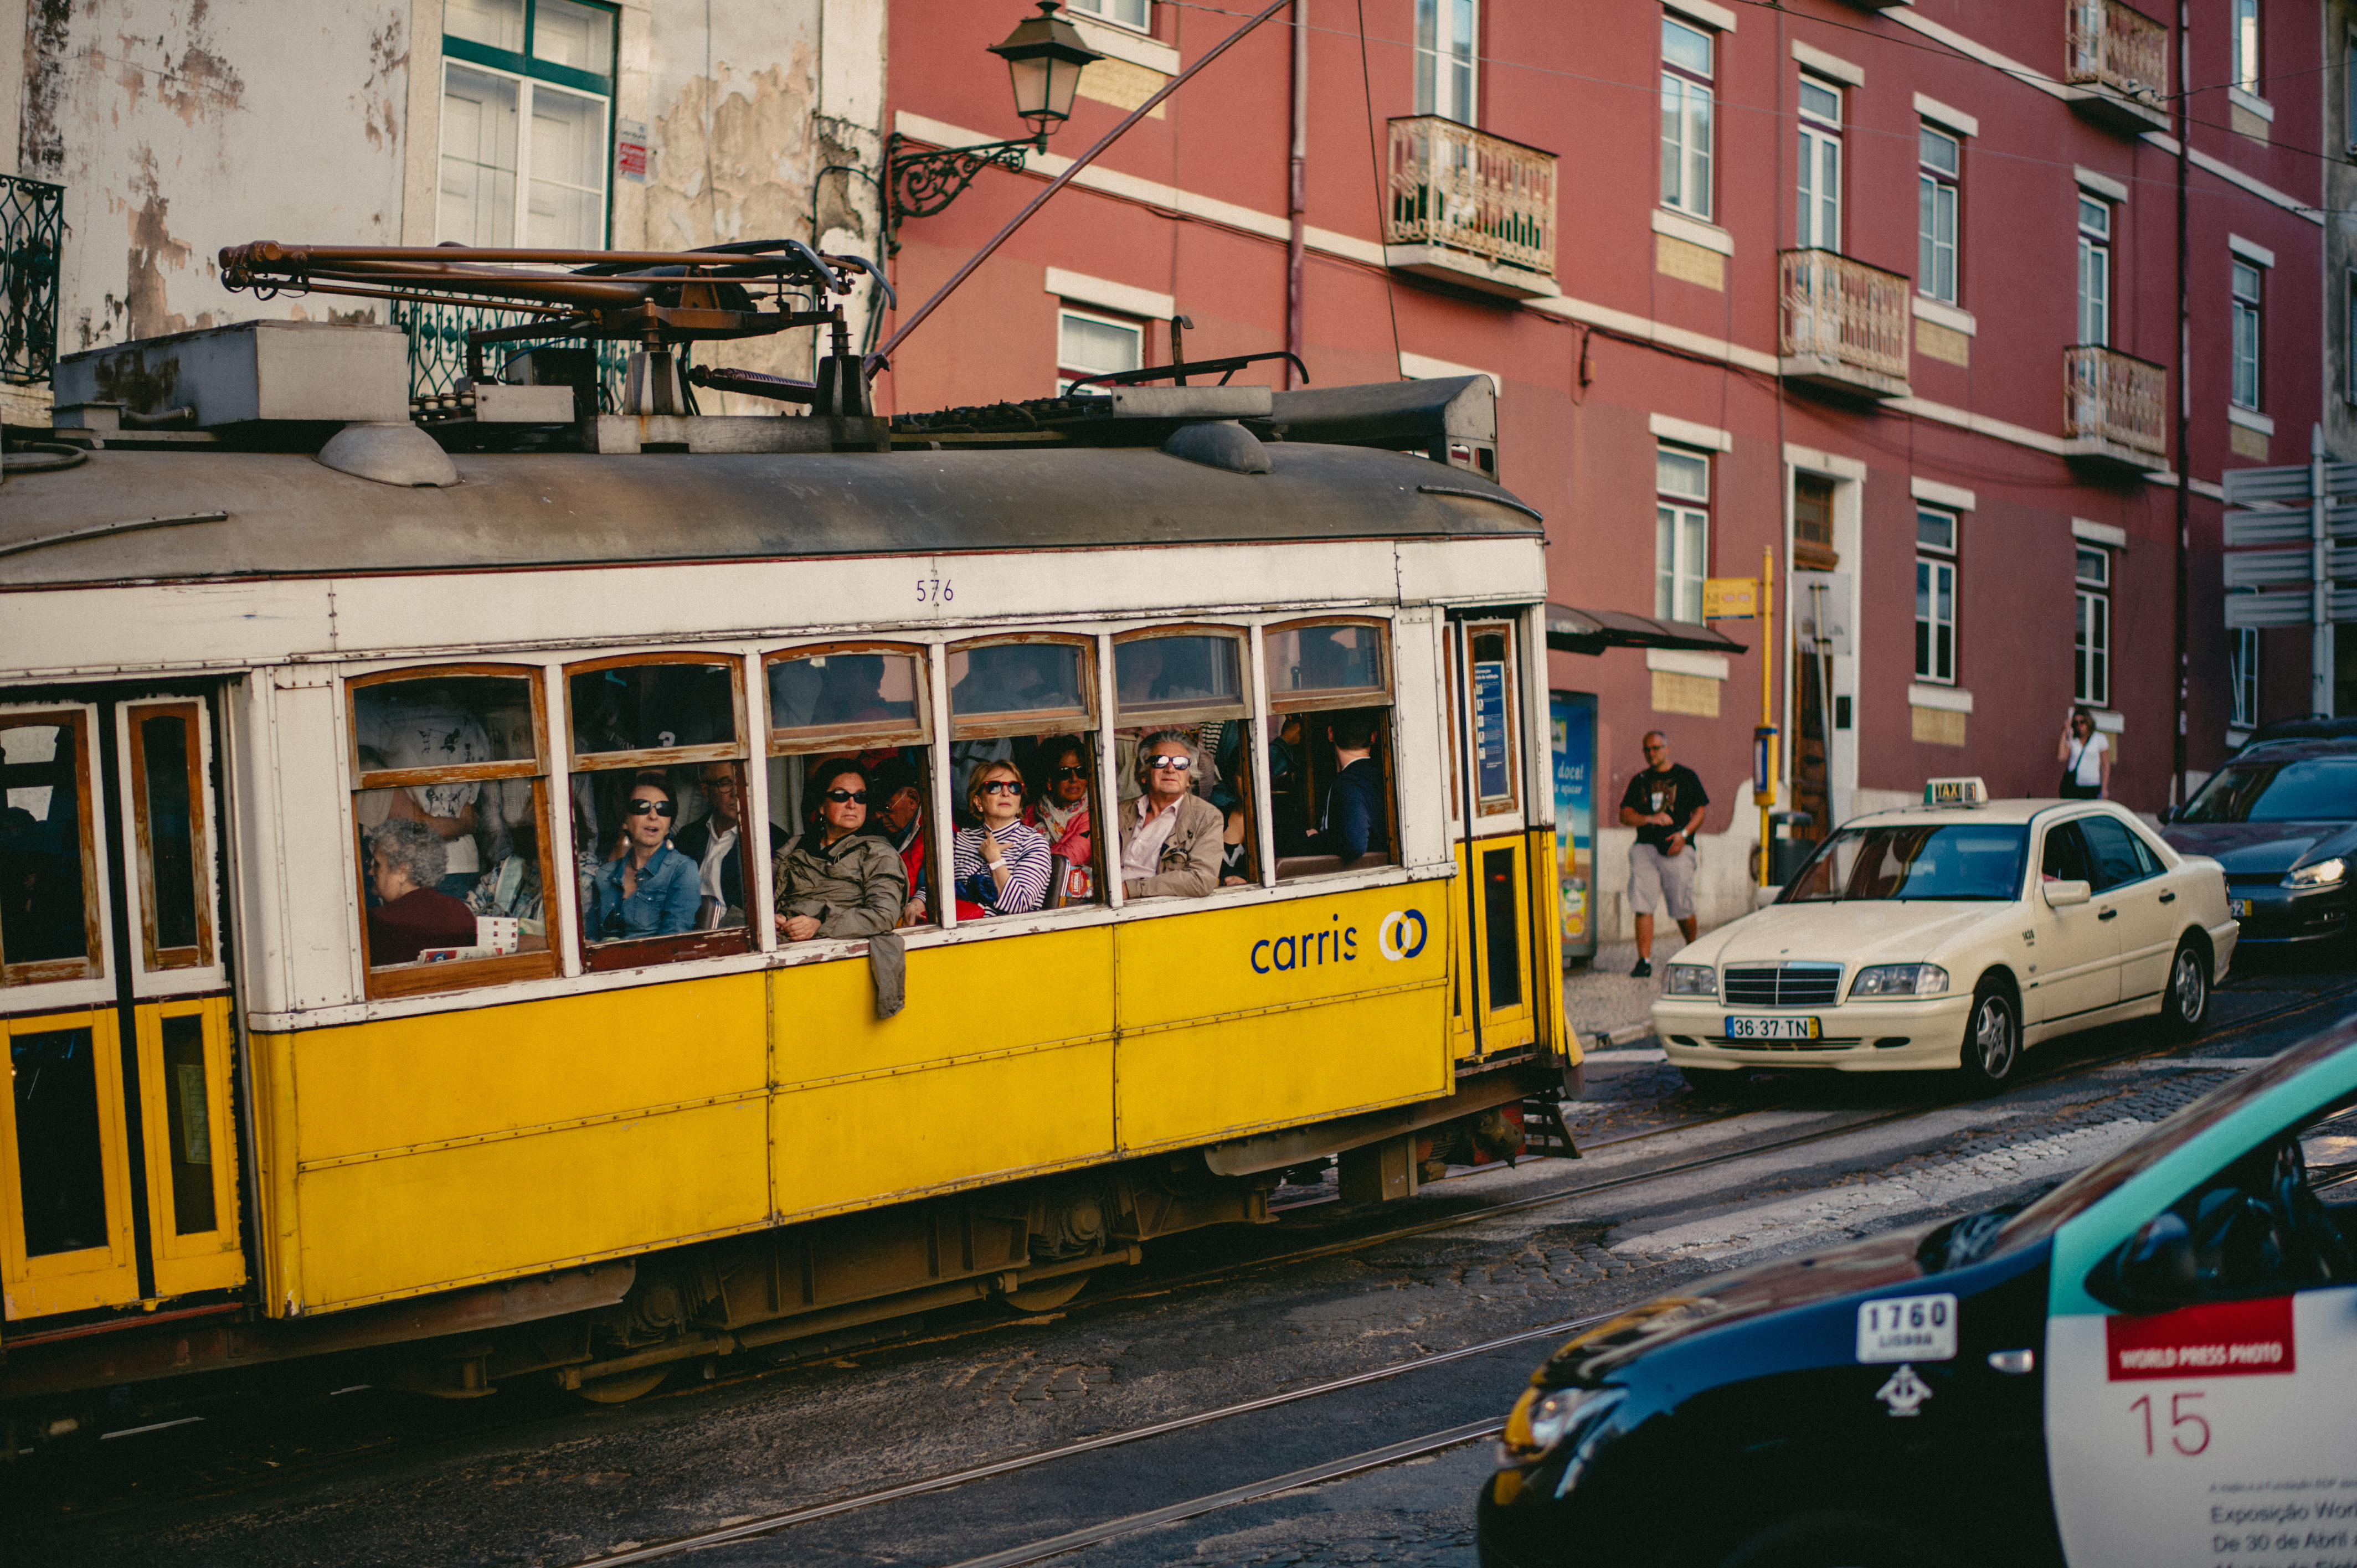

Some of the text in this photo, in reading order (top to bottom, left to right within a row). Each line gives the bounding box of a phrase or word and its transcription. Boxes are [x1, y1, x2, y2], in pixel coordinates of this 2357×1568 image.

[917, 579, 953, 602] 576
[1937, 783, 1962, 797] TAXI
[1250, 913, 1357, 974] carris
[1870, 1301, 1946, 1331] 1760
[2119, 1340, 2283, 1370] WORLD PRESS PHOTO
[2129, 1391, 2210, 1457] 15
[2211, 1503, 2309, 1524] Exposição
[2214, 1535, 2240, 1552] De
[2246, 1533, 2271, 1551] 30
[2275, 1533, 2299, 1551] de
[2304, 1531, 2347, 1549] Abril
